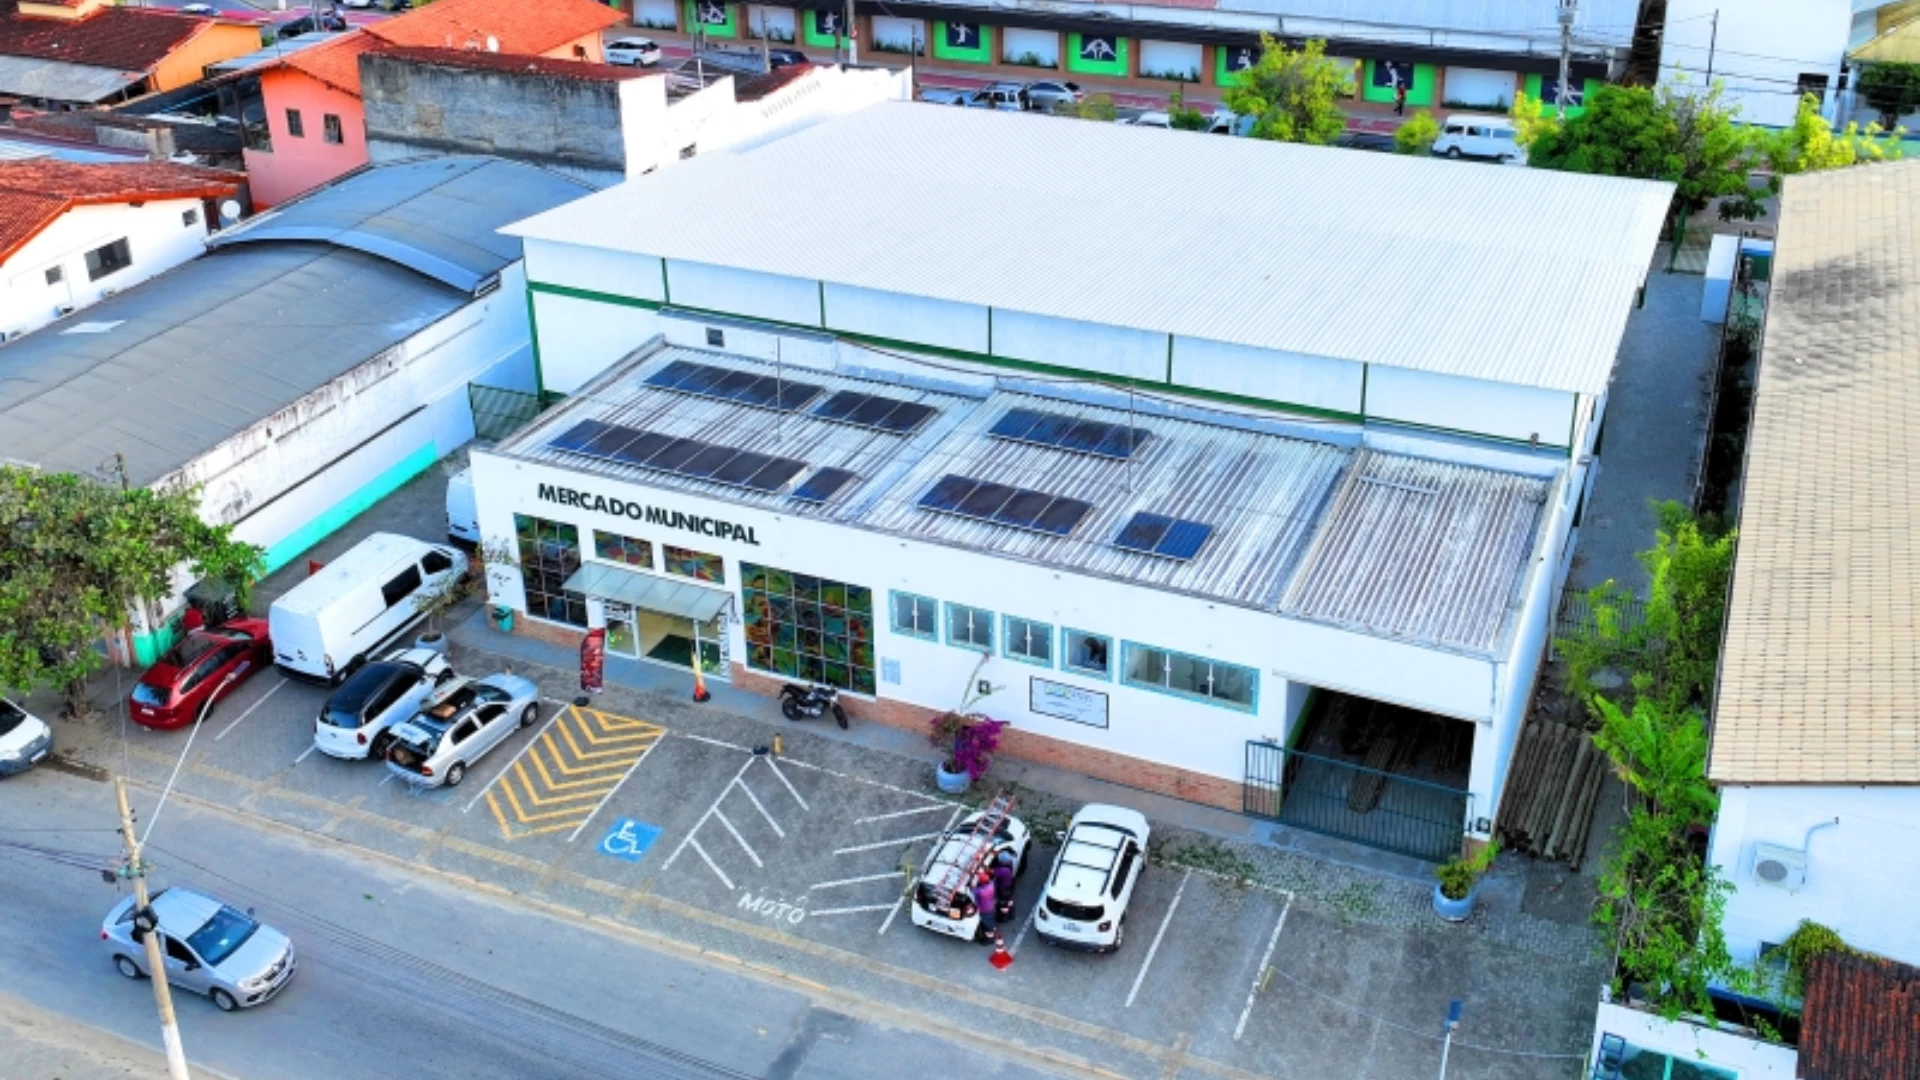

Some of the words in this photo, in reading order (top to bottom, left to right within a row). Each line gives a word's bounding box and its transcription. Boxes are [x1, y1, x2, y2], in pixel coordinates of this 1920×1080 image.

[538, 483, 642, 520] MERCADO
[645, 505, 760, 546] MUNICIPAL
[738, 892, 805, 924] MOTO
